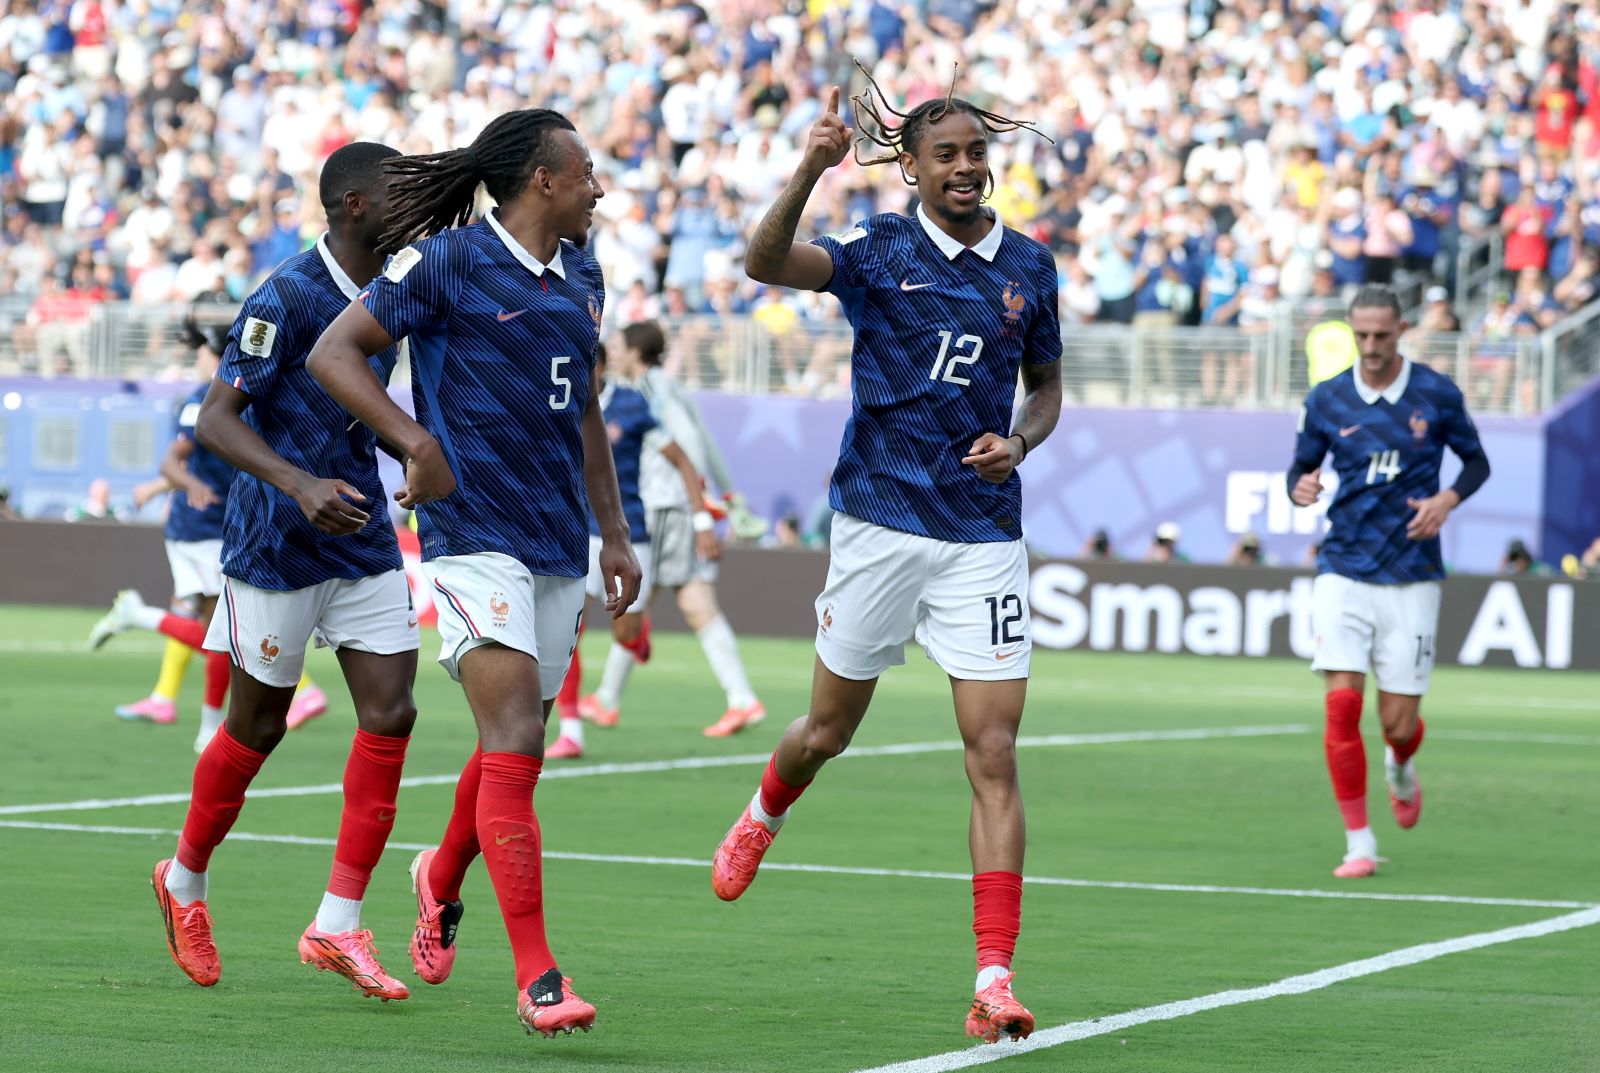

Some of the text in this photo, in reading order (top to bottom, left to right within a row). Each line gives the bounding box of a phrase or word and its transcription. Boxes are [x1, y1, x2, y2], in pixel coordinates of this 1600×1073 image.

[548, 356, 572, 410] 5
[929, 329, 984, 387] 12
[1366, 449, 1402, 485] 14
[1226, 471, 1340, 534] FIF
[984, 593, 1025, 646] 12
[1029, 563, 1574, 669] Smart AI
